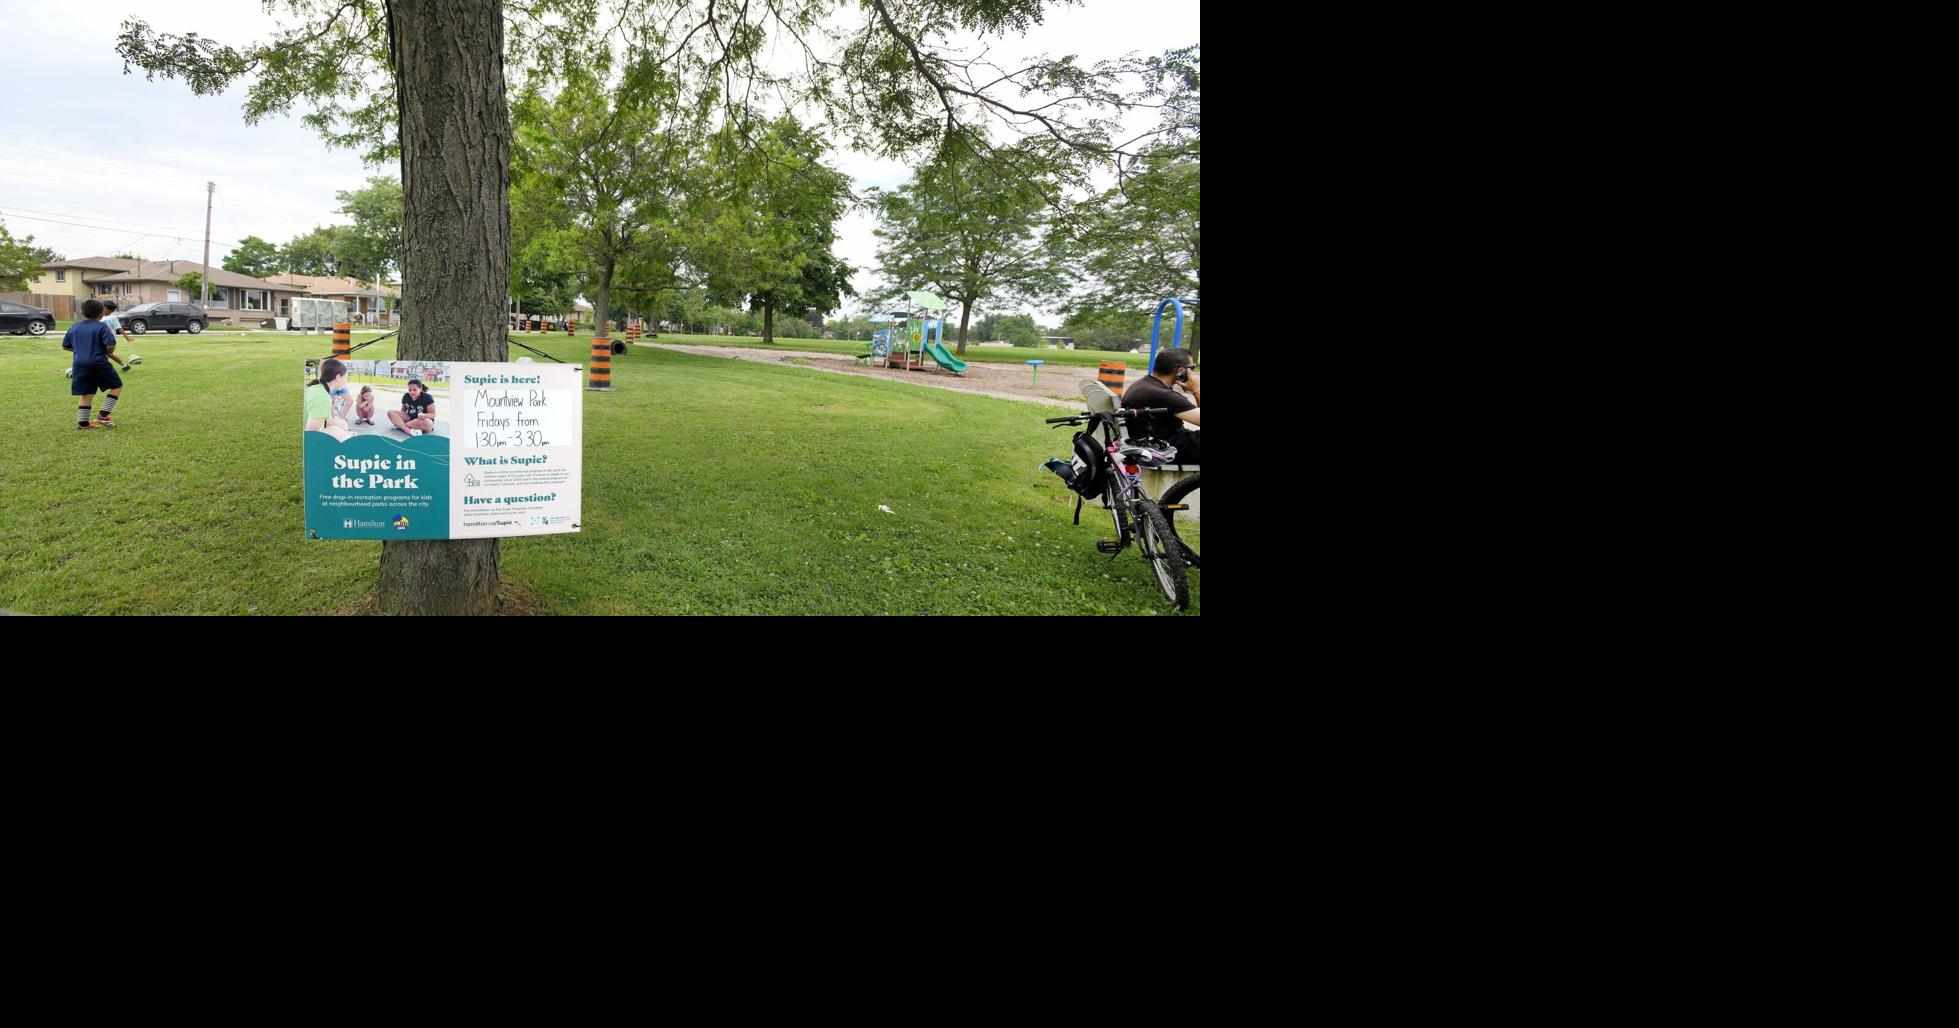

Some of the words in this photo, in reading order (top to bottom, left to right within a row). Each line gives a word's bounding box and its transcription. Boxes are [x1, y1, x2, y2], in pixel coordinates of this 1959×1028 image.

[464, 375, 498, 386] Supie
[500, 375, 509, 384] is
[511, 375, 541, 384] here!
[474, 389, 523, 407] Mountview
[529, 389, 548, 407] Park
[477, 411, 510, 430] Fridays
[516, 411, 539, 427] from
[334, 454, 392, 473] Supie
[395, 454, 416, 470] in
[464, 456, 497, 466] What
[500, 455, 509, 465] is
[510, 454, 548, 466] Supie?
[332, 473, 365, 489] the
[368, 473, 419, 489] Park
[383, 494, 411, 502] programs
[463, 495, 493, 505] Have
[503, 492, 557, 505] question?
[353, 519, 385, 528] Hamilton
